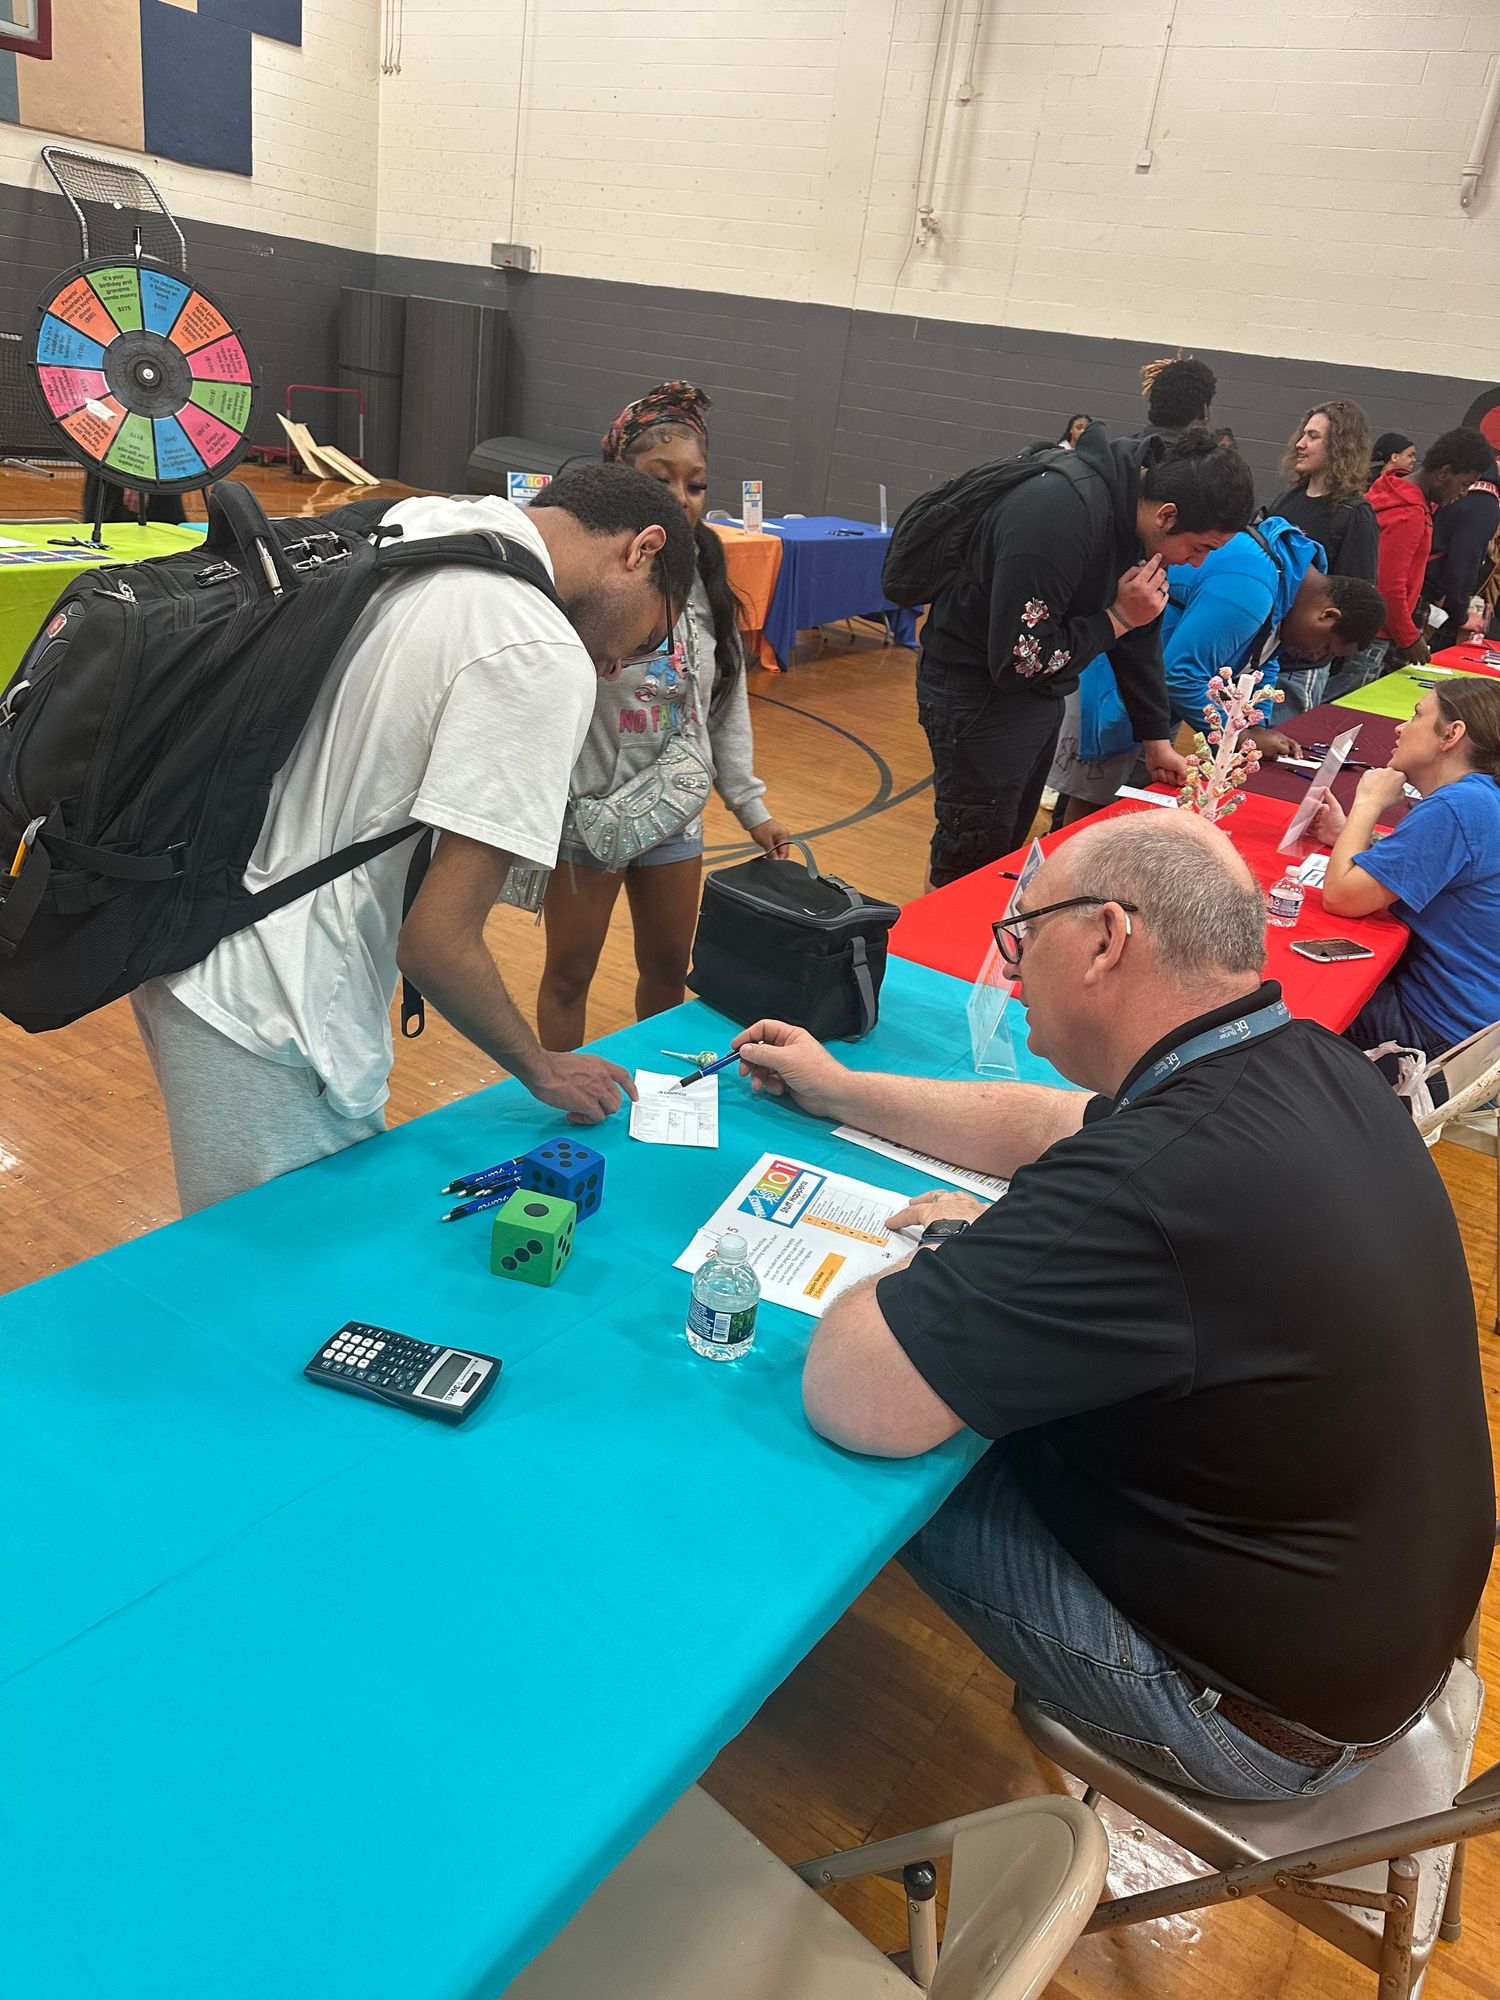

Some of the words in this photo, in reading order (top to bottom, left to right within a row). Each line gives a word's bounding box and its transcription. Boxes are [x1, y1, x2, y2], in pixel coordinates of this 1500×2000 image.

[98, 280, 121, 289] birthday
[105, 286, 130, 294] grandma
[154, 284, 171, 294] bonus
[59, 294, 84, 318] anniversary
[81, 287, 90, 296] and
[66, 312, 75, 322] you
[79, 292, 95, 309] buying
[77, 305, 91, 319] dinner
[185, 312, 199, 326] needs
[194, 306, 205, 317] falls
[208, 320, 216, 329] the
[198, 301, 208, 312] Cell
[206, 310, 221, 326] phone
[191, 310, 204, 323] toilet
[202, 322, 212, 332] and
[183, 318, 204, 340] replaced
[227, 353, 238, 373] beyond
[73, 425, 82, 435] get
[77, 421, 93, 438] refund
[81, 417, 95, 431] share
[94, 430, 104, 440] and
[100, 428, 109, 437] the
[81, 433, 99, 452] Parents
[91, 436, 100, 445] tax
[117, 445, 137, 456] garage
[126, 454, 145, 465] money
[619, 709, 647, 733] NO
[1233, 1018, 1249, 1034] bt
[1218, 1029, 1237, 1040] Butler
[1165, 1052, 1179, 1066] bt
[761, 1162, 799, 1191] 101
[786, 1179, 810, 1203] Happens
[779, 1200, 794, 1214] Stuff
[805, 1280, 818, 1296] Supplies
